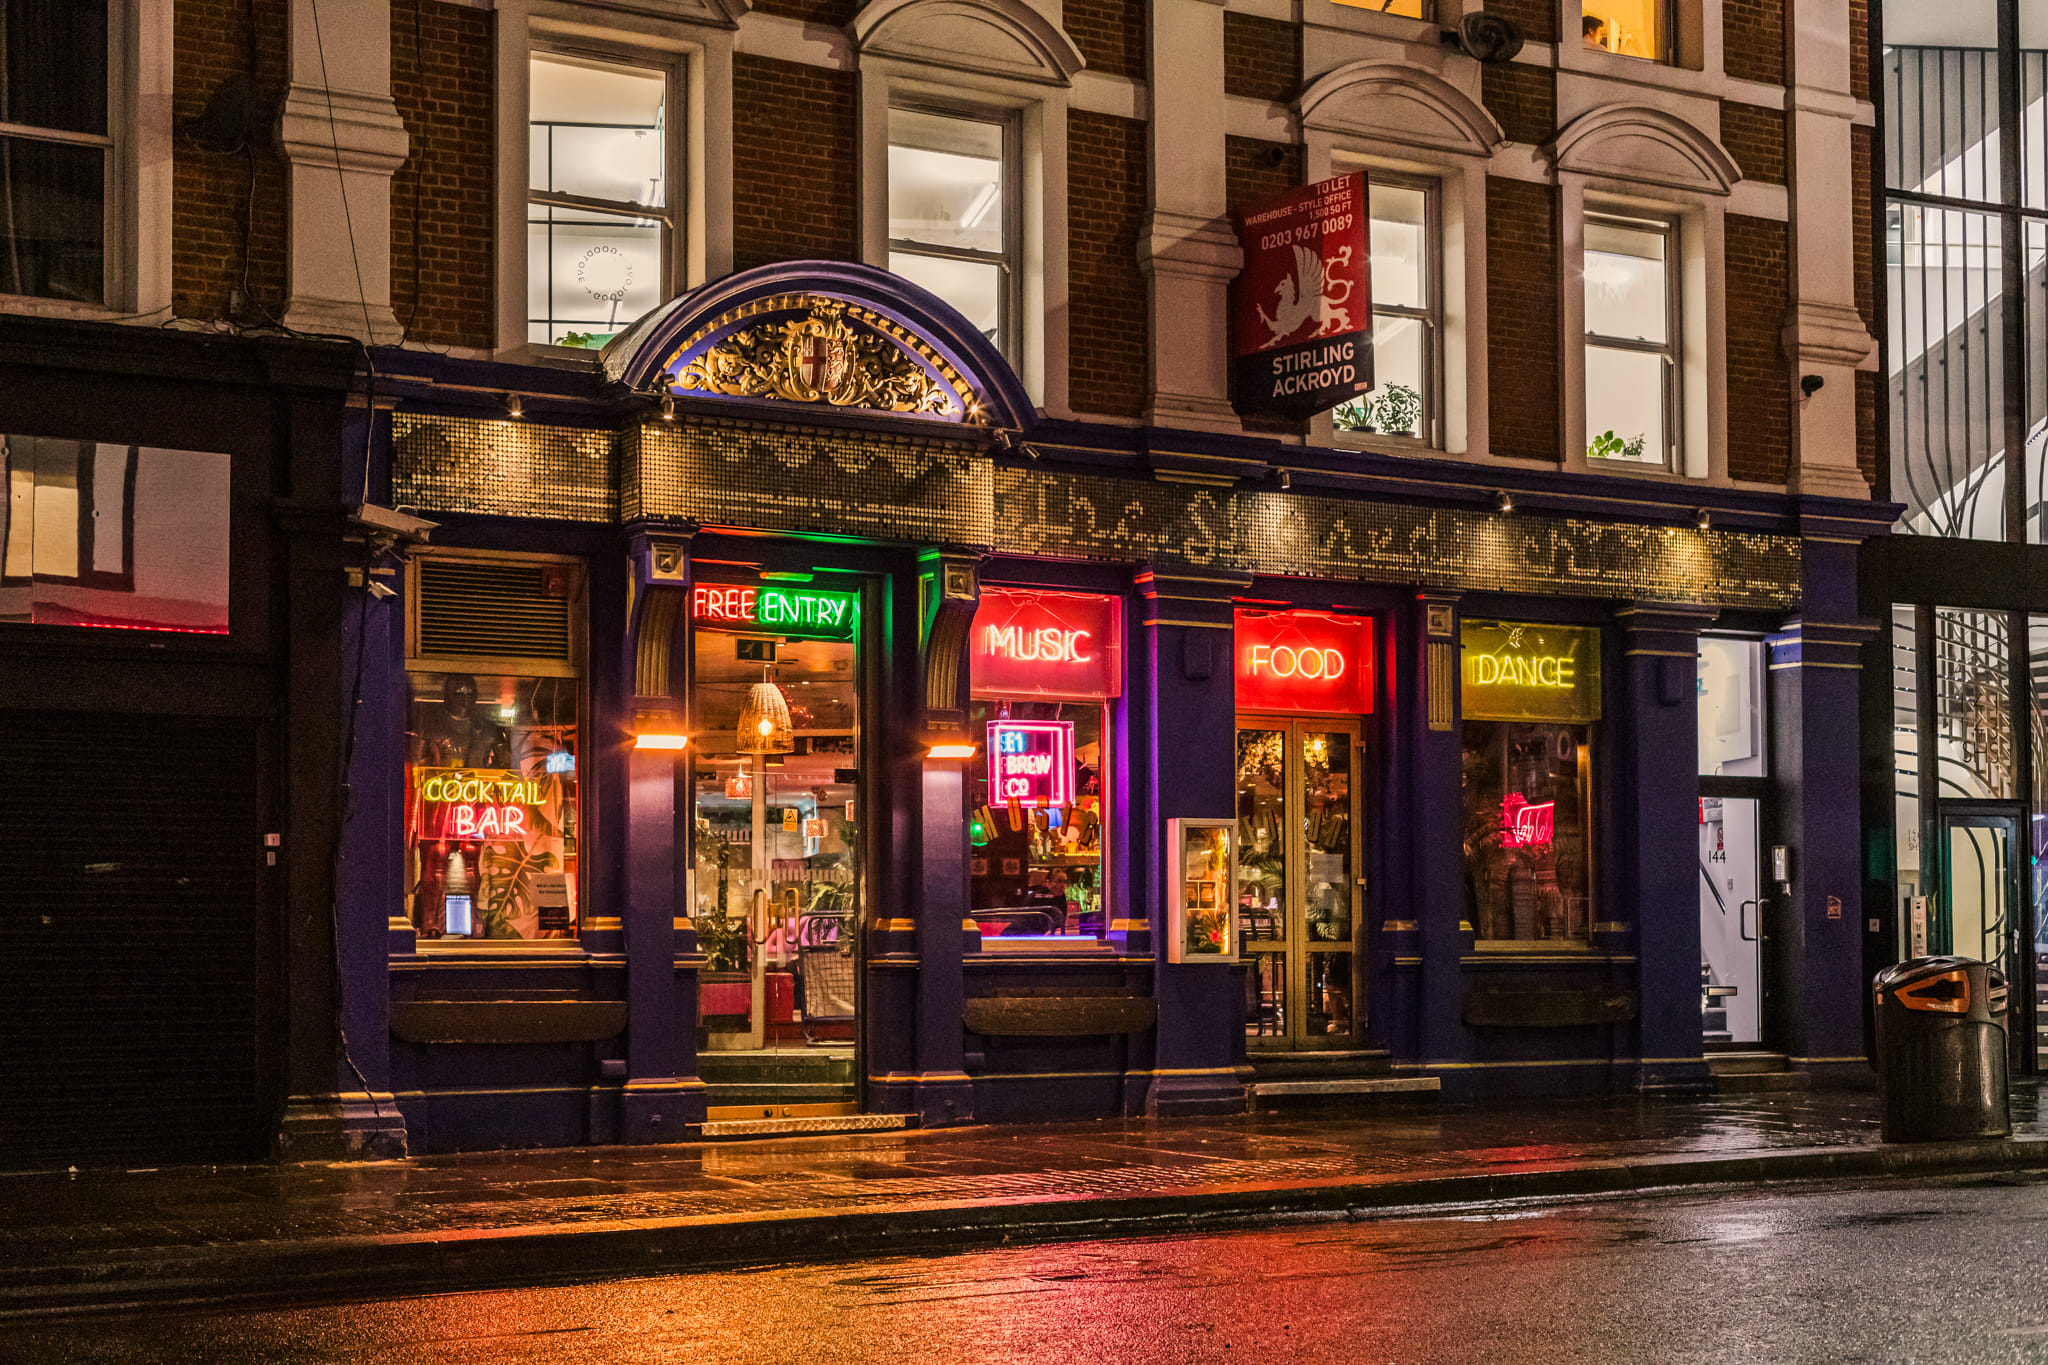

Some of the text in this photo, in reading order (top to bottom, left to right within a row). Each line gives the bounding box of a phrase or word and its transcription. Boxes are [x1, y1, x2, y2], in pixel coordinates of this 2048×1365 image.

[1299, 198, 1322, 213] STYLE
[1324, 189, 1352, 206] OFFICE
[1316, 175, 1351, 195] TO LET
[1342, 200, 1352, 212] FT
[1261, 213, 1353, 251] 0203 967 0089
[1272, 341, 1354, 376] STIRLING
[1272, 364, 1356, 398] ACKROYD
[694, 588, 846, 626] FREE ENTRY
[989, 624, 1091, 662] MUSIC
[1252, 645, 1344, 680] FOOD
[1479, 654, 1575, 688] DANCE
[1006, 755, 1051, 775] BREW
[456, 805, 526, 835] BAR
[1709, 850, 1726, 864] 144
